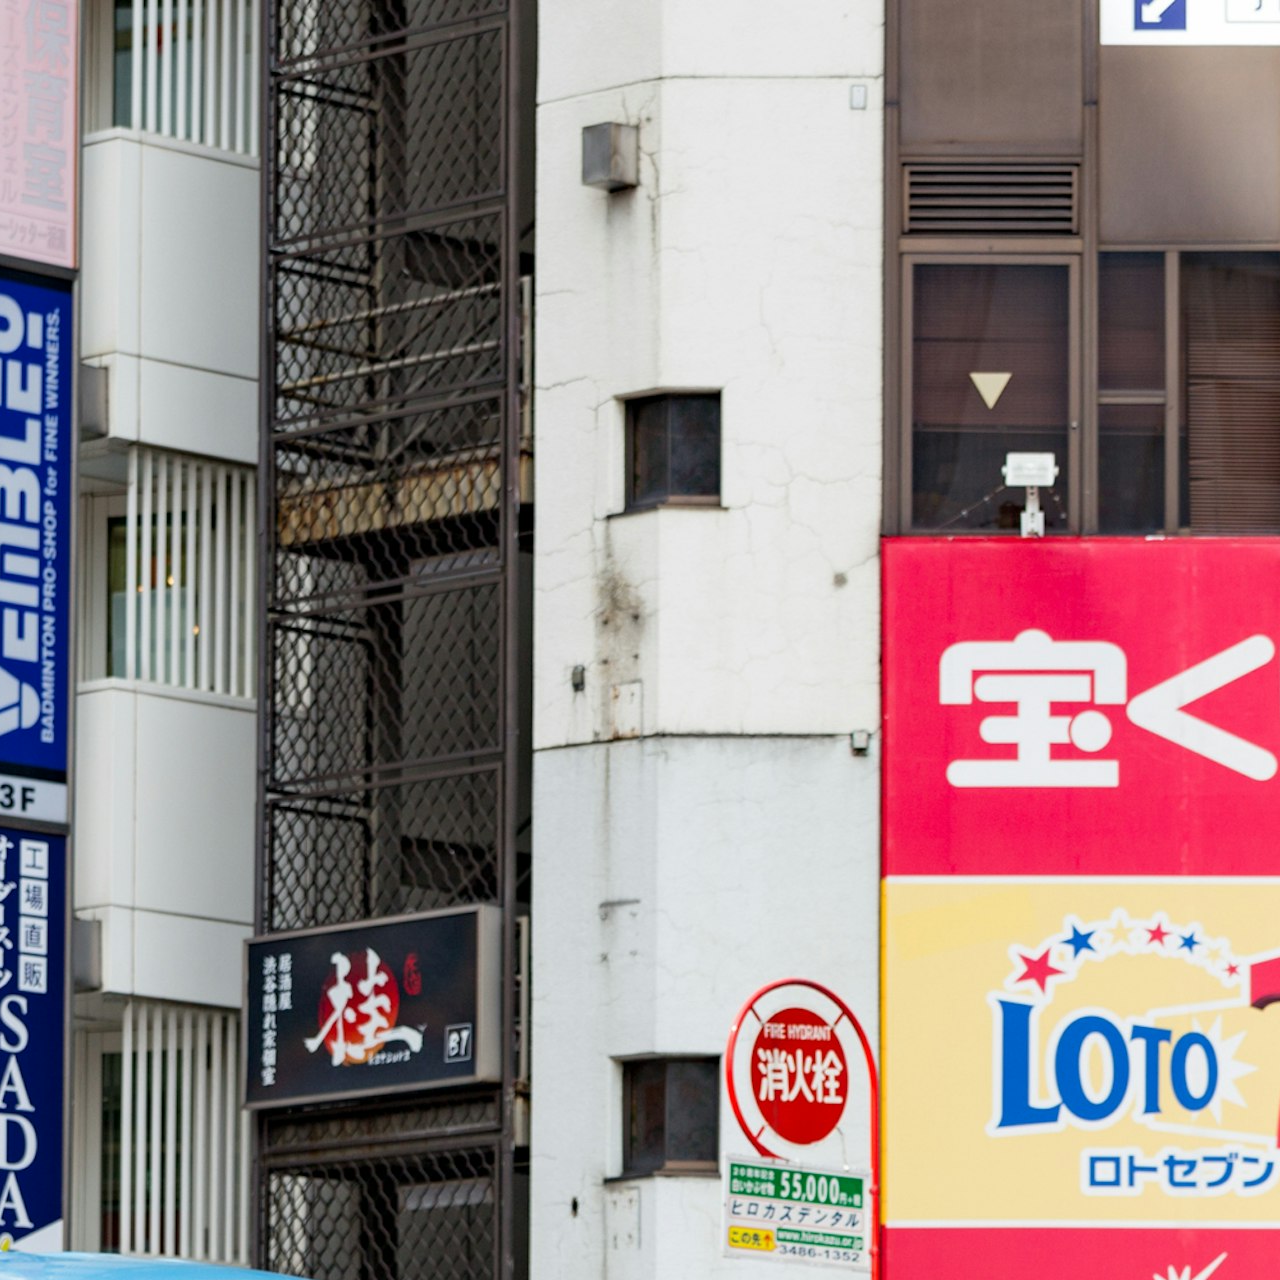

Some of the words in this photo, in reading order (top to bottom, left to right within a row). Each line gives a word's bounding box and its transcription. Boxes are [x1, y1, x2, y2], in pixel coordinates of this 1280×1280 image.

[43, 413, 59, 463] FINE
[43, 468, 58, 497] for
[42, 500, 58, 609] PRO-SHOP
[40, 612, 56, 744] BADMINTON
[23, 844, 46, 989] 工場直販
[303, 947, 427, 1067] 桂
[763, 1022, 786, 1041] FIRE
[787, 1024, 832, 1042] HYDRANT
[756, 1047, 844, 1105] 消火栓
[995, 997, 1219, 1129] LOTO
[1088, 1151, 1275, 1188] ロトセブン
